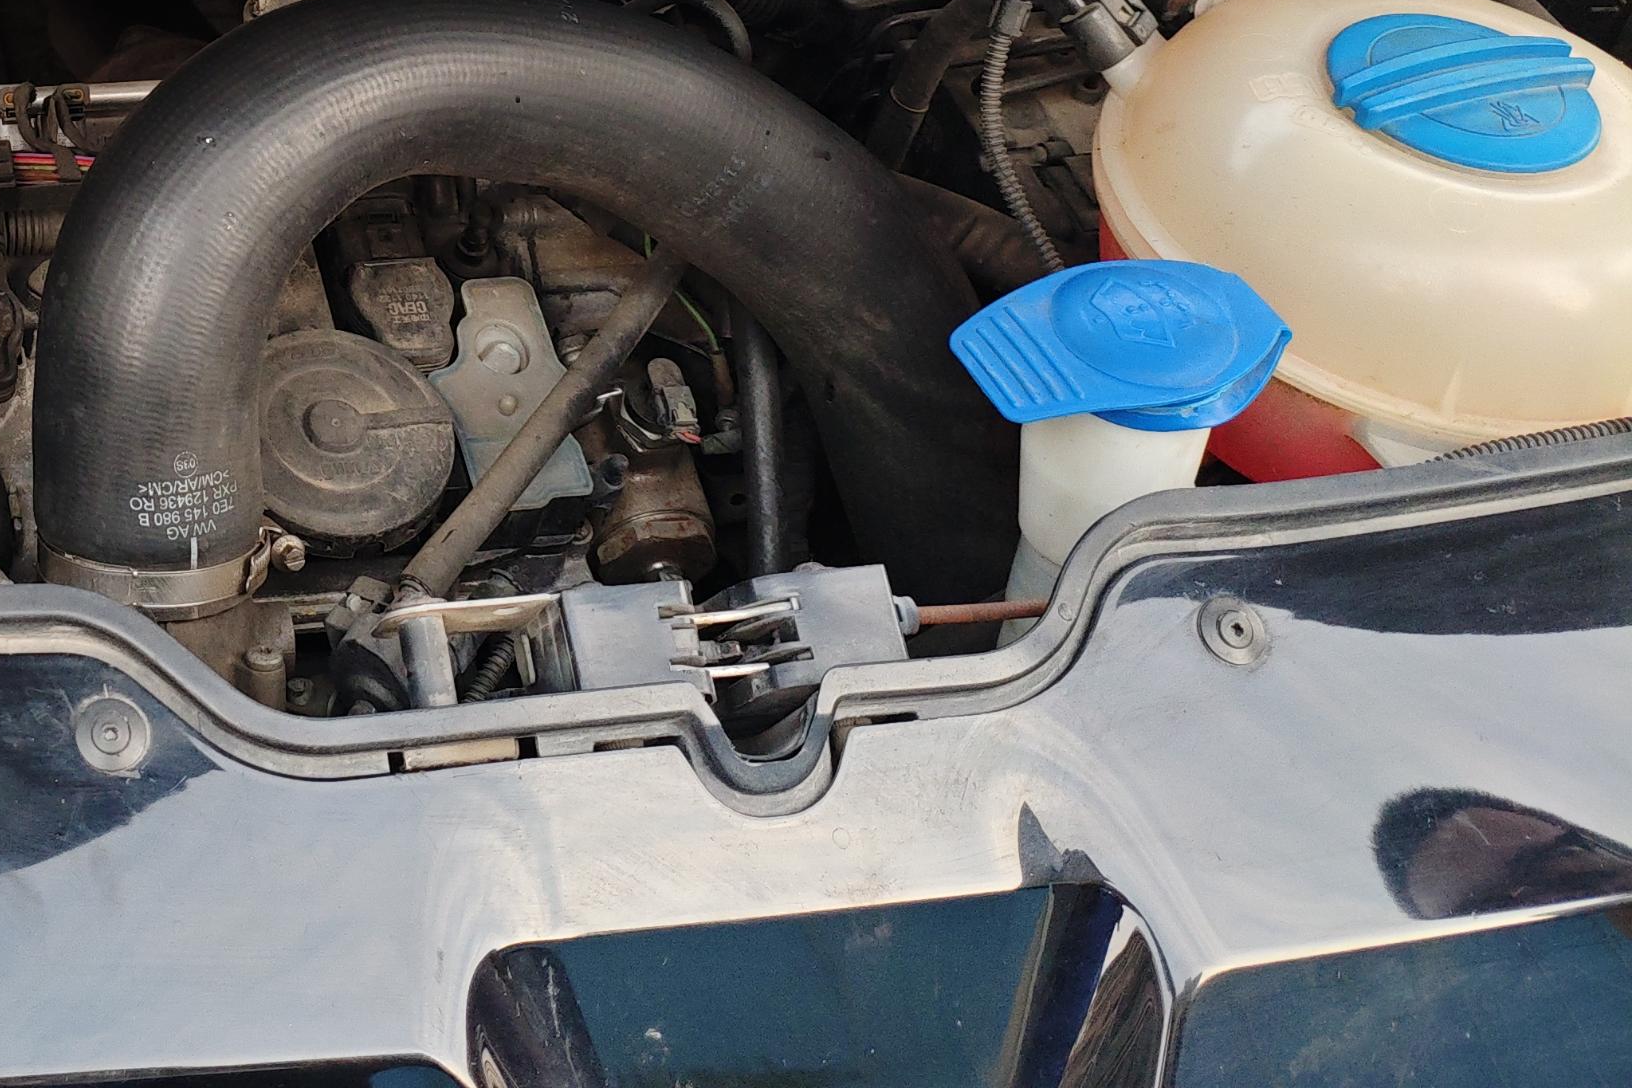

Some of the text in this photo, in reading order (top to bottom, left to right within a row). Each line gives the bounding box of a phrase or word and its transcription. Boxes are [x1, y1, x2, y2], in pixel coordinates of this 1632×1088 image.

[129, 480, 238, 511] PXR 129436 RO
[138, 497, 235, 527] 7E0 145 980 B
[166, 519, 217, 541] VW AG
